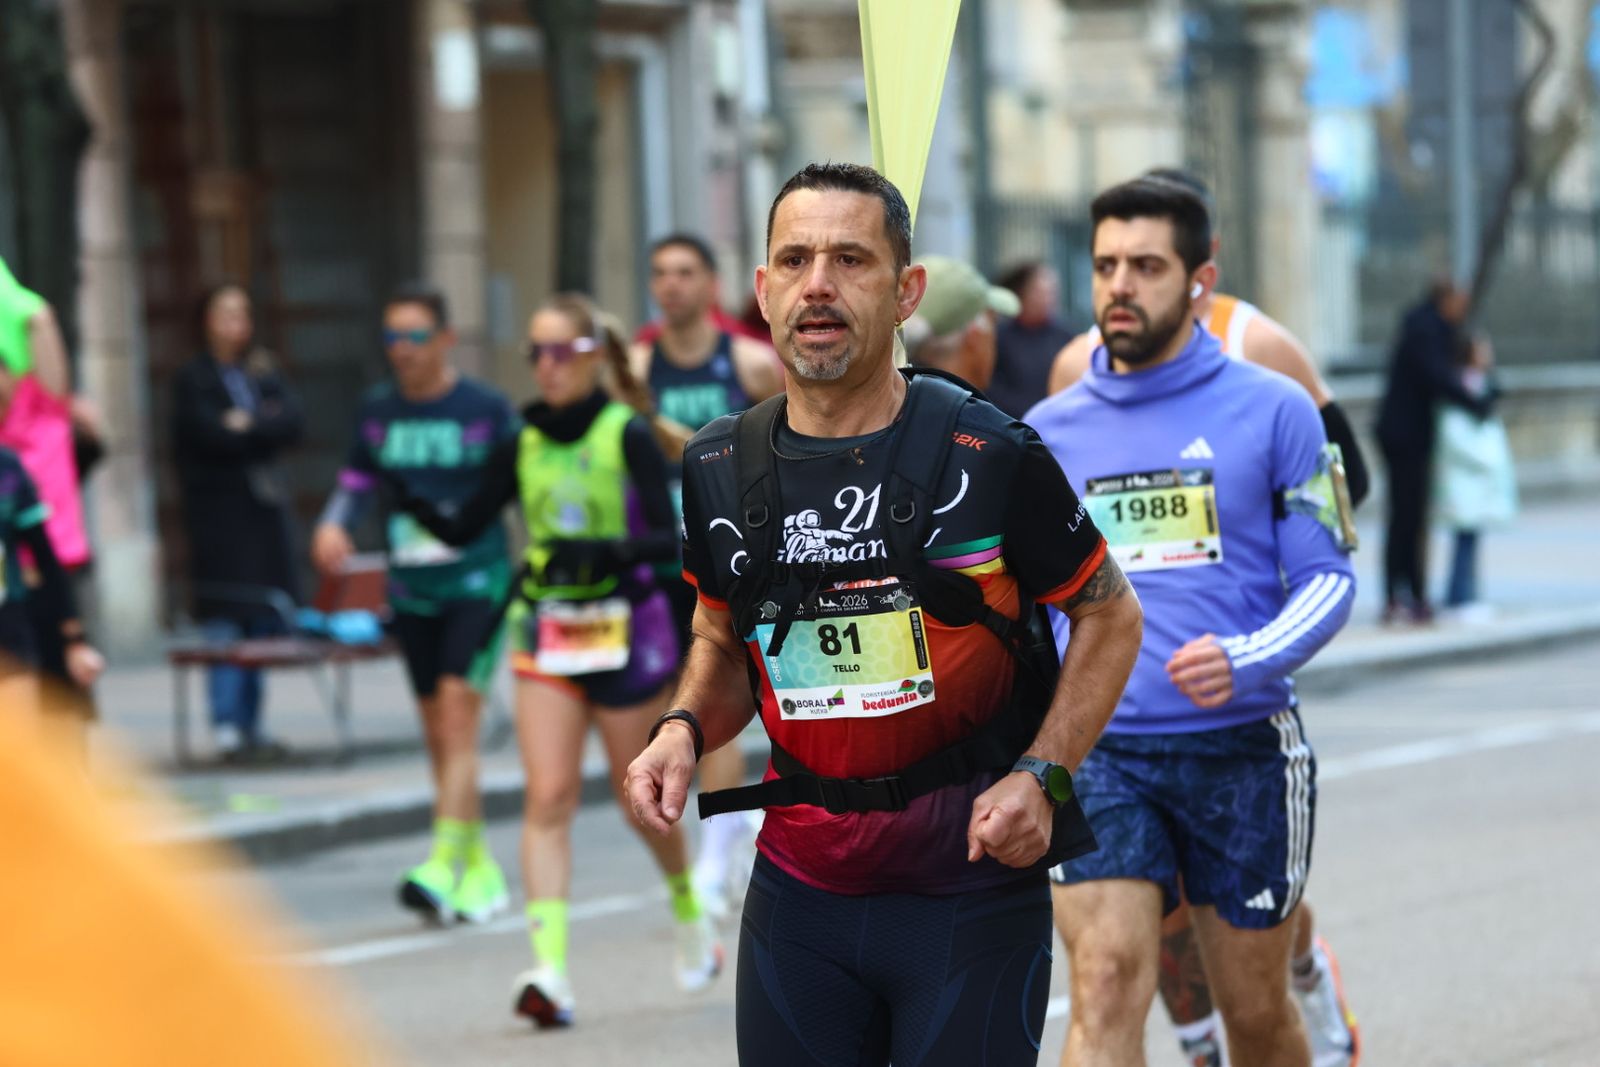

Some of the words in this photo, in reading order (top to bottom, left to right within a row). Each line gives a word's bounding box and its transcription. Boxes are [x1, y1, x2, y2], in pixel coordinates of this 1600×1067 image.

[699, 451, 720, 460] MEDIA
[834, 483, 882, 533] 21
[1110, 494, 1188, 523] 1988
[1067, 504, 1086, 533] LAB
[840, 594, 868, 607] 2026
[818, 622, 861, 656] 81
[832, 664, 861, 673] TELLO
[793, 698, 826, 709] ABORAL
[862, 692, 918, 711] bedunia
